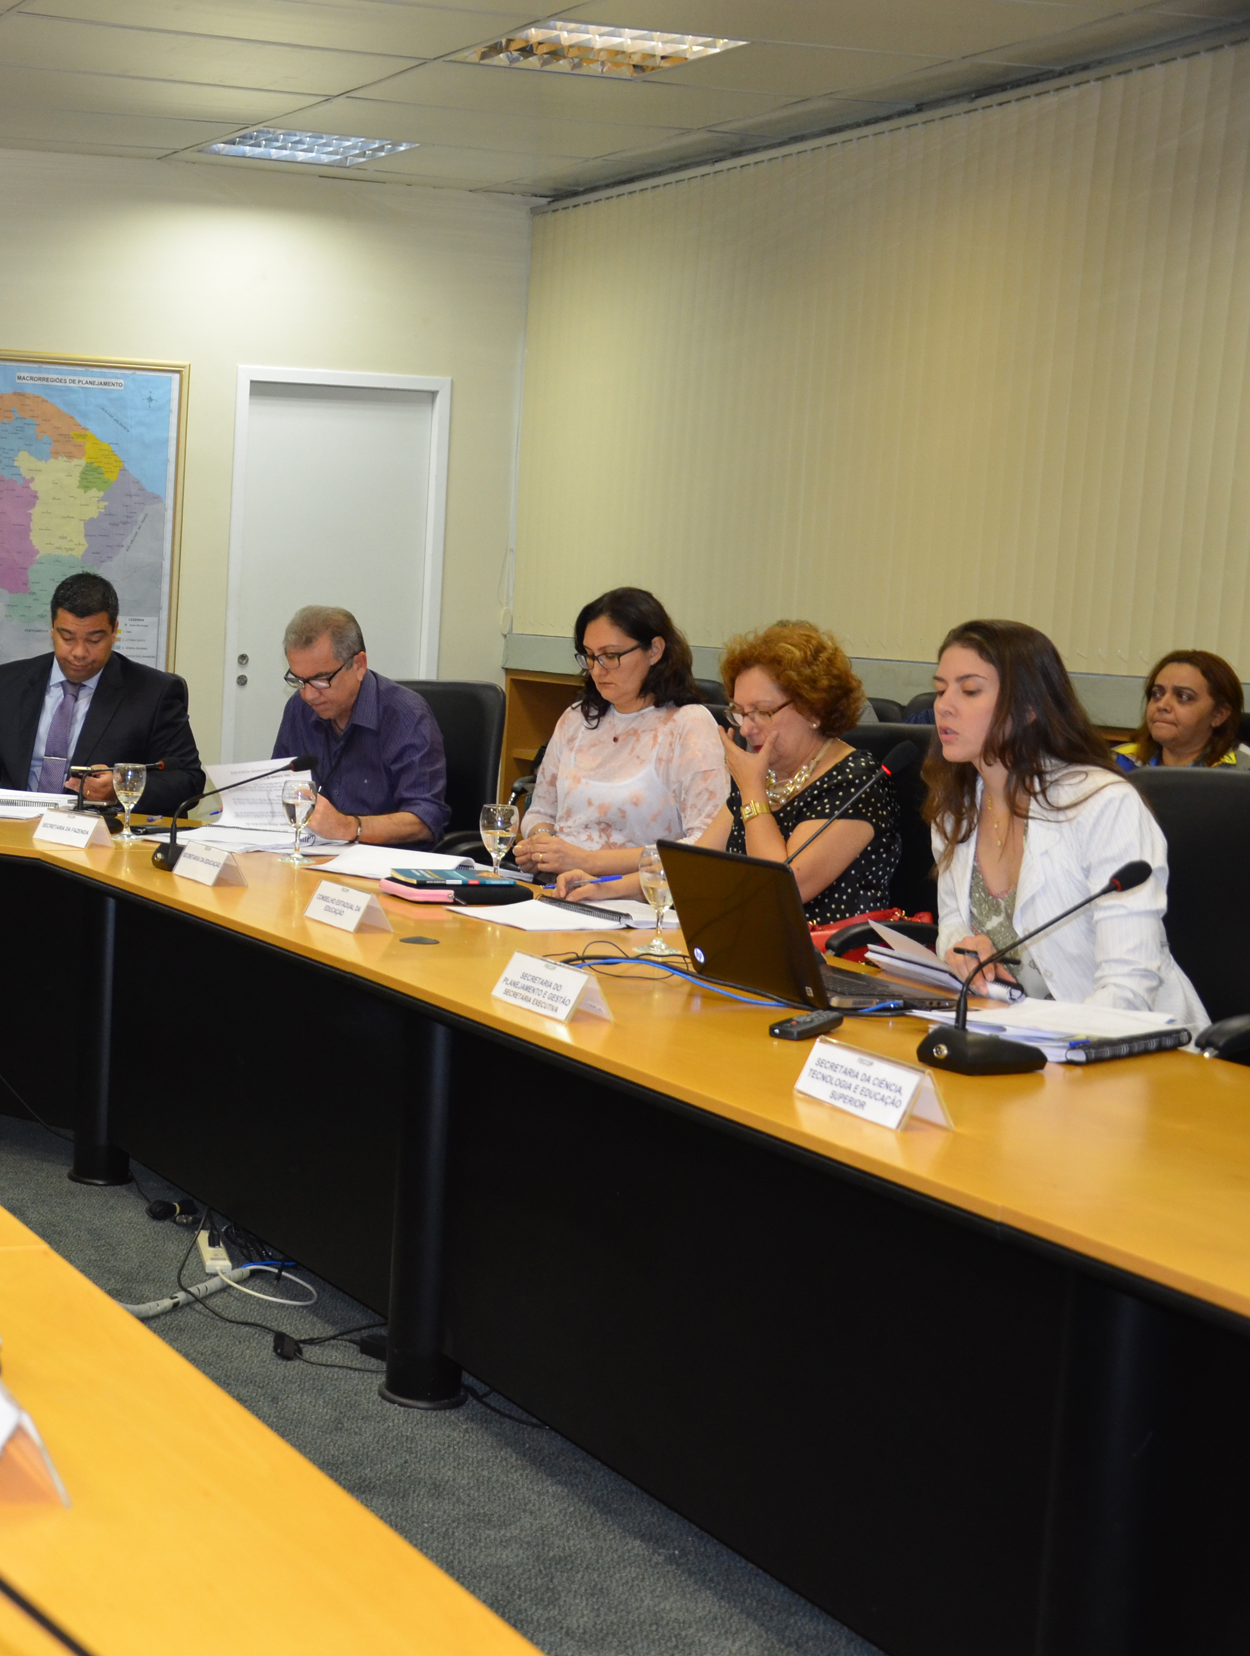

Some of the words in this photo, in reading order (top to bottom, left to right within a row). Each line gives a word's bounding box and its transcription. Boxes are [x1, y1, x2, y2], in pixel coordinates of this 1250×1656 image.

[17, 375, 67, 384] MACRORREGIÕES
[77, 379, 123, 388] PLANEJAMENTO
[42, 822, 64, 831] SECRETARIA
[71, 826, 89, 836] FAZENDA
[502, 977, 542, 997] PLANEJAMENTO
[547, 992, 571, 1006] GESTÃO
[520, 972, 553, 988] SECRETARIA
[552, 982, 563, 992] DO
[503, 988, 532, 1003] SECRETARIA
[532, 997, 559, 1013] EXECUTIVA
[815, 1057, 859, 1079] SECRETARIA
[860, 1073, 871, 1083] DA
[872, 1076, 903, 1096] CIÊNCIA,
[807, 1068, 851, 1091] TECNOLOGIA
[859, 1087, 902, 1109] EDUCAÇÃO
[829, 1090, 867, 1110] SUPERIOR
